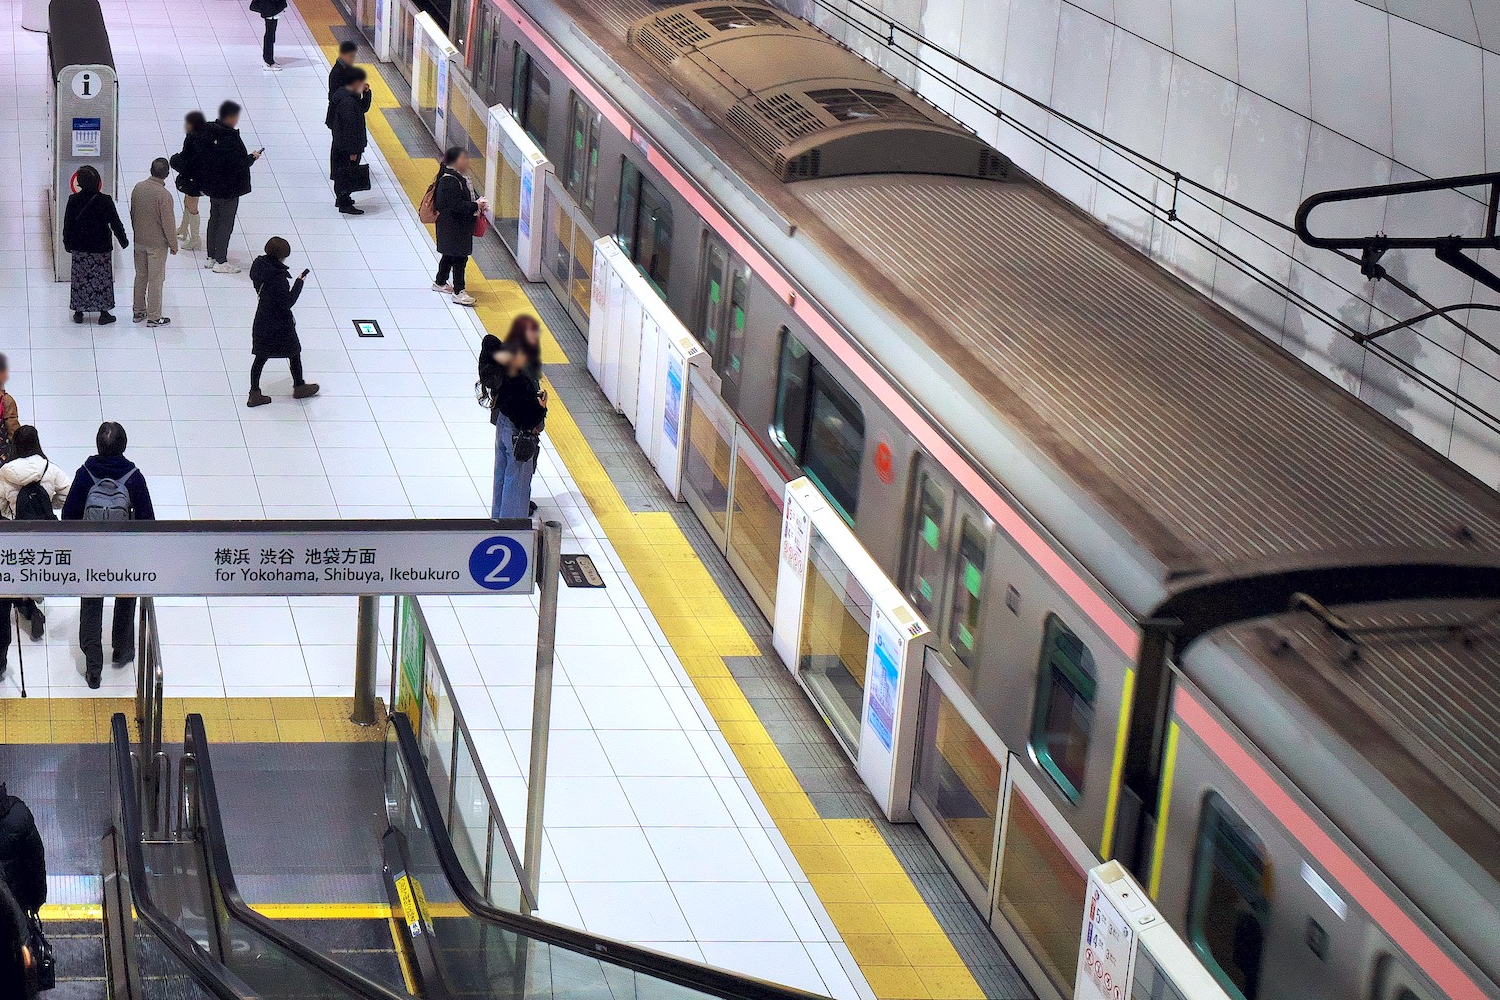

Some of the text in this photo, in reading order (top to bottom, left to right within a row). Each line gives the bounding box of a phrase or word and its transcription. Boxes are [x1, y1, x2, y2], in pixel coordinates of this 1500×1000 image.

[0, 548, 72, 566] 池袋方面
[214, 547, 377, 565] 横浜 渋谷 池袋方面
[483, 543, 513, 583] 2
[20, 568, 81, 585] Shibuya,
[86, 568, 157, 582] Ikebukuro
[214, 567, 460, 584] for Yokohama, Shibuya, Ikebukuro
